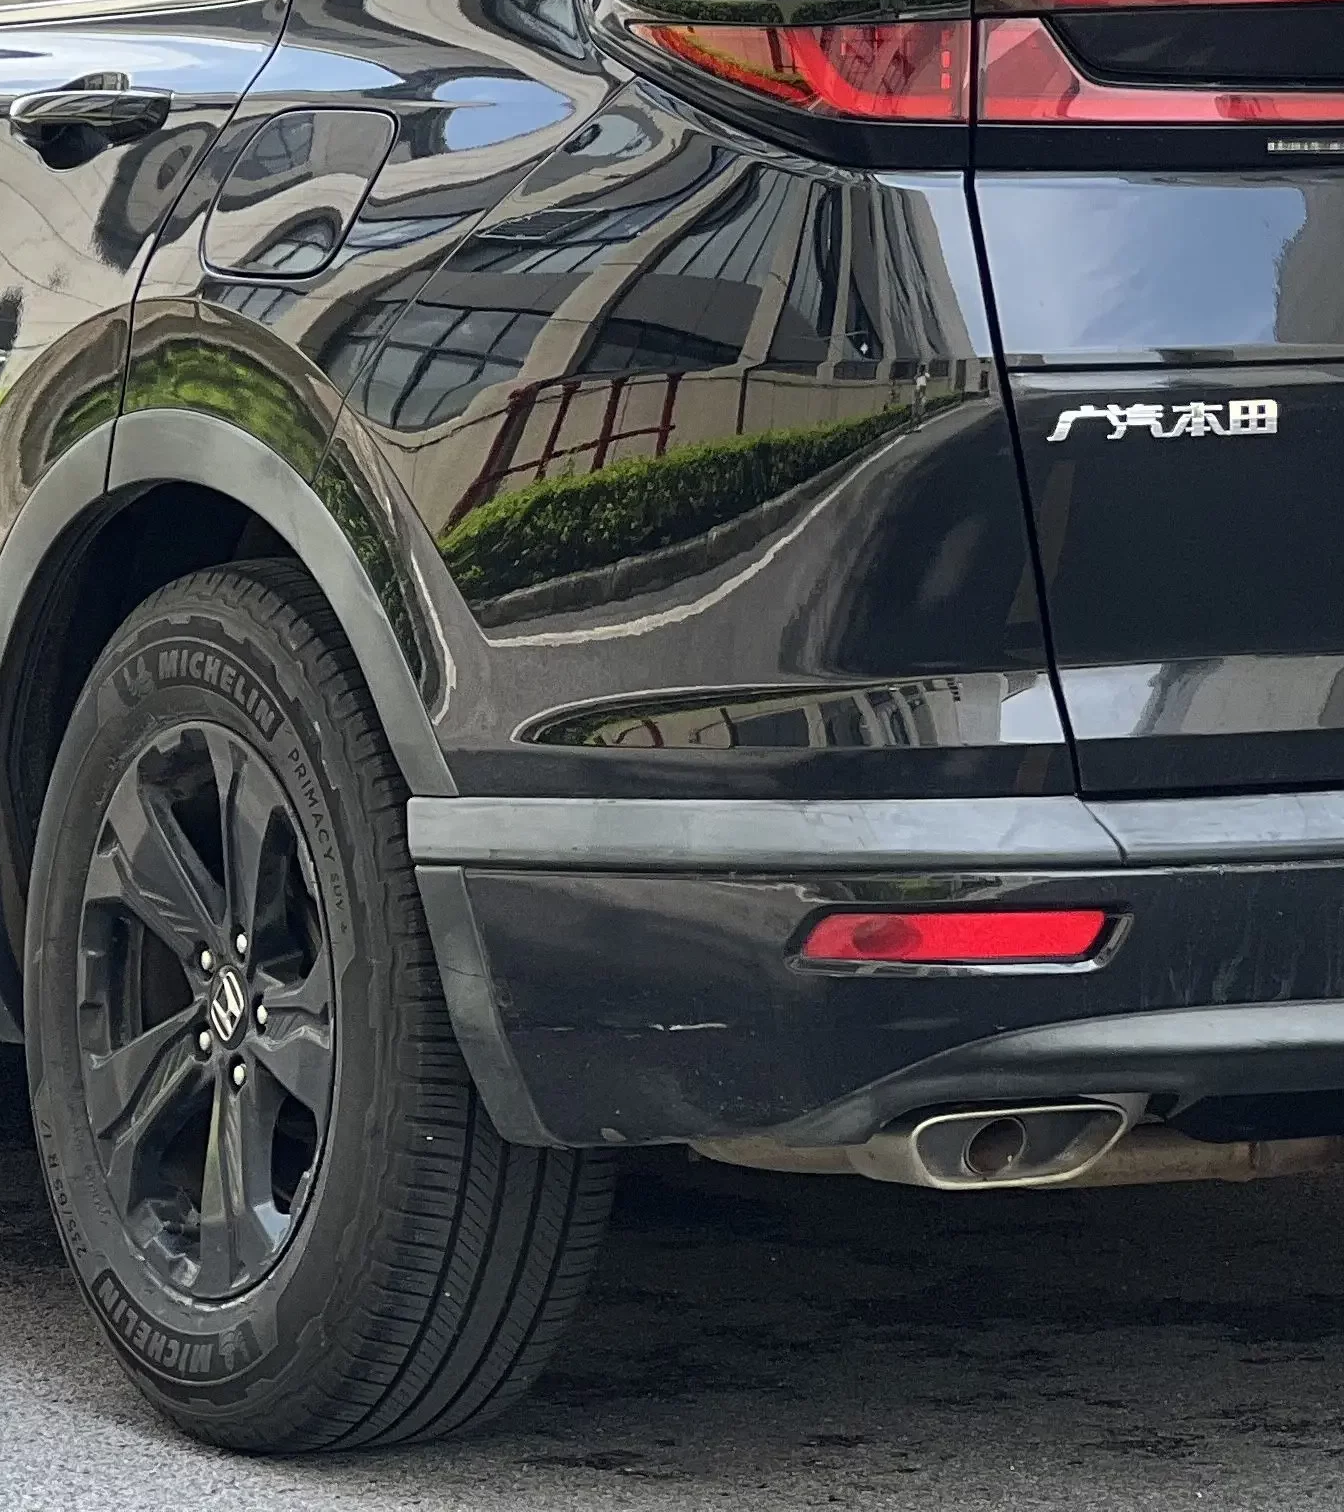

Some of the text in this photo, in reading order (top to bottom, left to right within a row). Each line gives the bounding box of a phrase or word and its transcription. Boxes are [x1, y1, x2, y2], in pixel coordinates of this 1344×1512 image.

[1046, 399, 1278, 442] 广汽本田
[158, 648, 277, 734] MICHELIN
[288, 747, 336, 863] PRIMACY
[98, 1277, 214, 1374] MICHELIN
